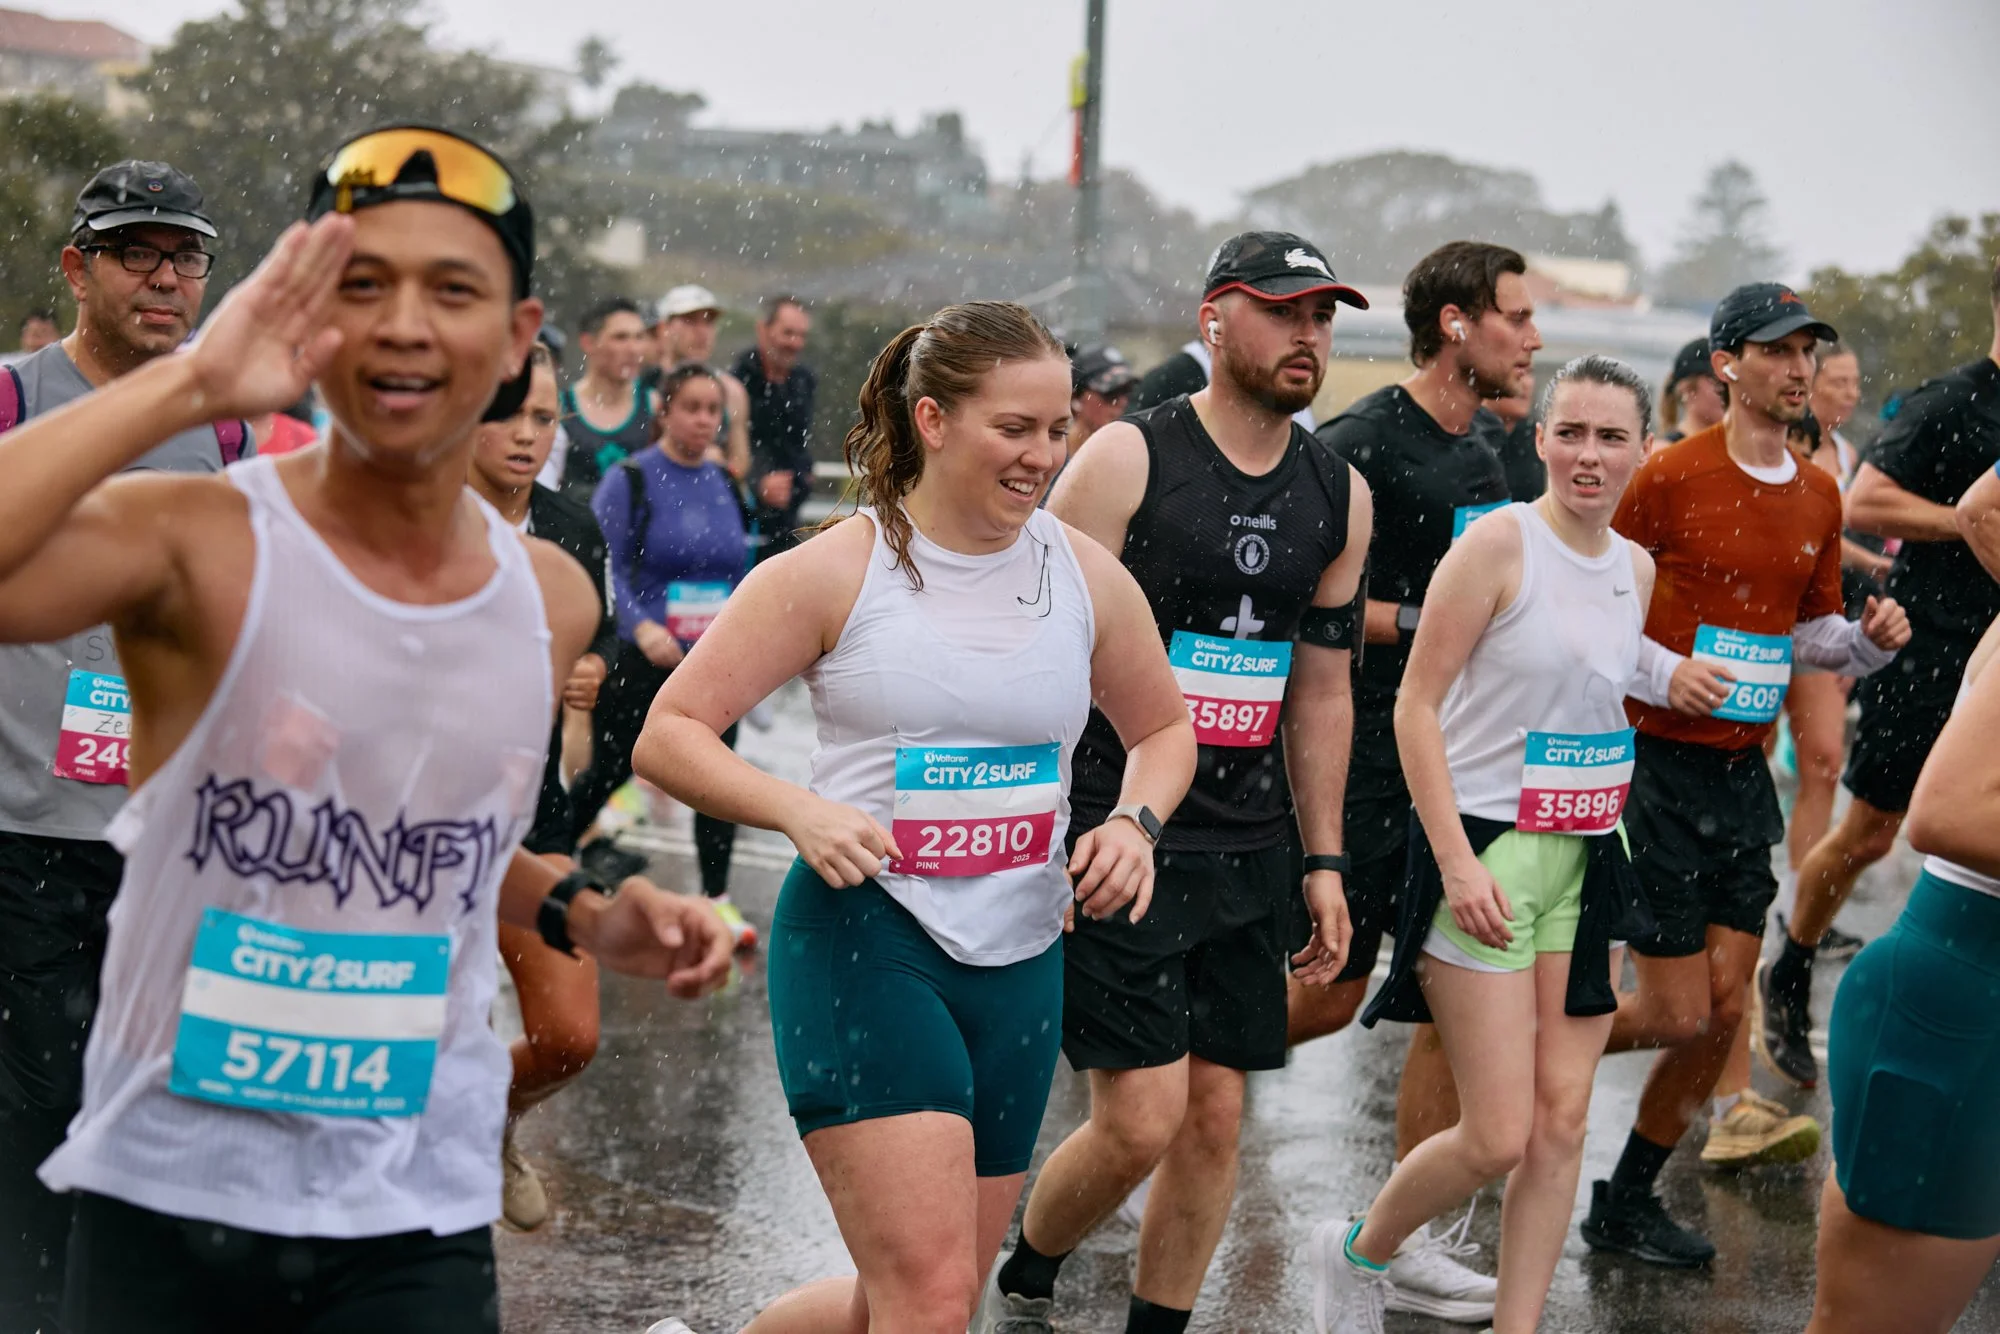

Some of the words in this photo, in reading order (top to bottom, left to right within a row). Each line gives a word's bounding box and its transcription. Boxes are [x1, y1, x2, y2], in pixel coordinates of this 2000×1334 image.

[1191, 651, 1278, 672] CITY2SURF
[94, 712, 131, 735] Ze
[935, 754, 968, 763] Voltaren
[1545, 745, 1626, 765] CITY2SURF
[924, 762, 1037, 786] CITY2SURF
[1535, 789, 1620, 818] 35896
[917, 820, 1034, 858] 22810
[915, 861, 940, 870] PINK
[1011, 853, 1030, 863] 2025
[231, 944, 416, 990] CITY2SURF
[221, 1028, 391, 1093] 57114
